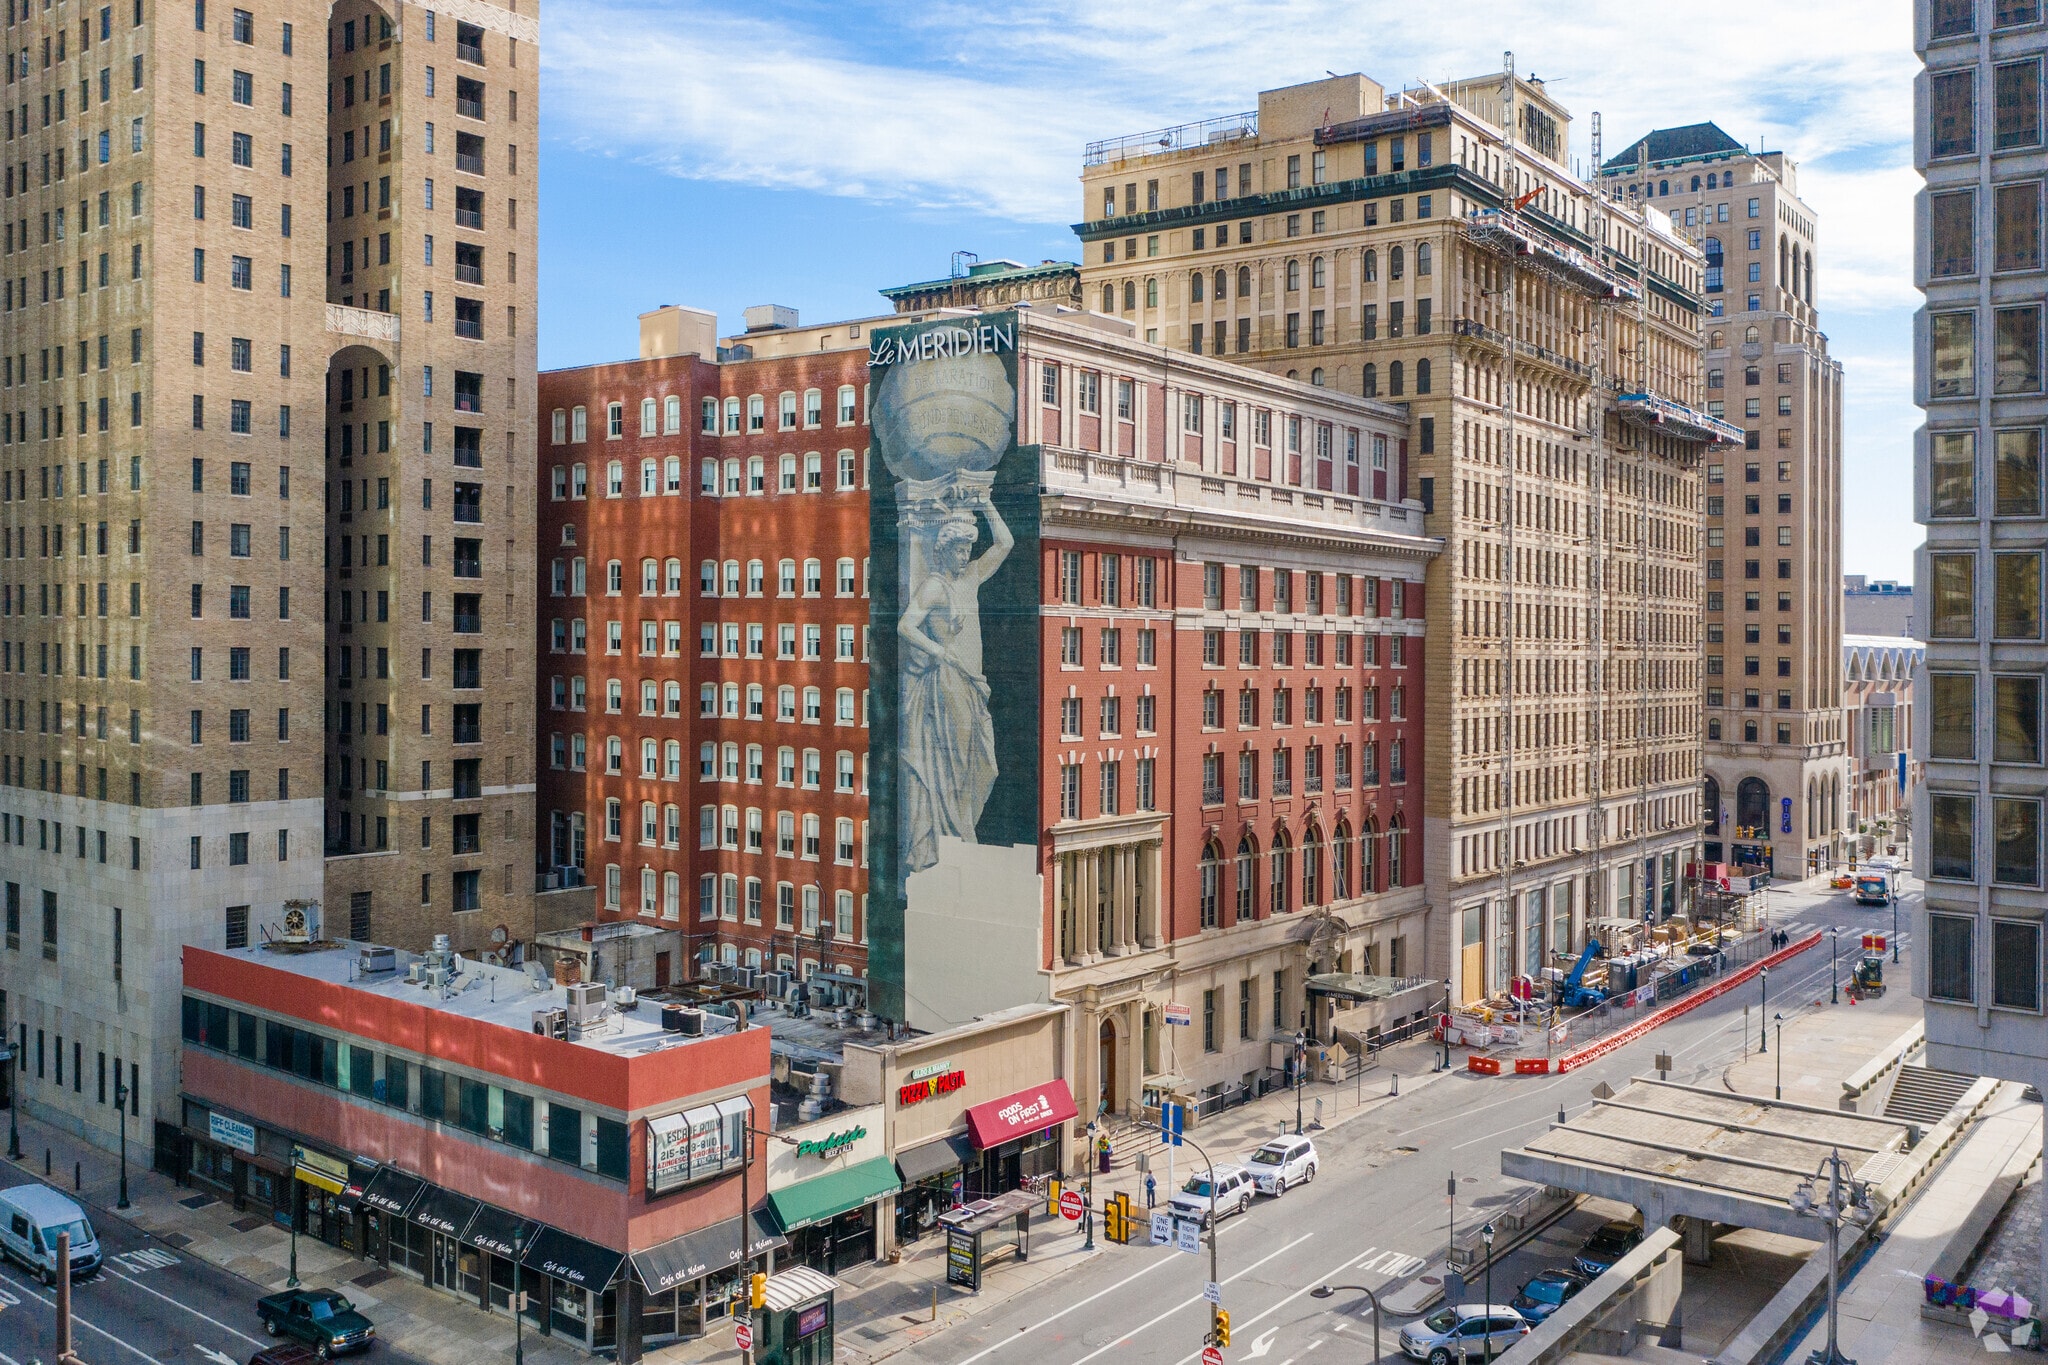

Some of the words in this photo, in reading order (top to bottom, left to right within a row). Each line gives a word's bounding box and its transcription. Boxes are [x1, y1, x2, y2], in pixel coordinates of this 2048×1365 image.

[866, 337, 895, 366] Le
[898, 322, 1014, 363] MERIDIEN
[914, 366, 995, 393] DECLARATION
[900, 1081, 929, 1105] PIZZA
[938, 1070, 966, 1094] PASTA
[998, 1102, 1023, 1120] FOODS
[1008, 1115, 1020, 1126] ON
[1020, 1103, 1039, 1120] FIRST
[797, 1125, 867, 1159] Parkside
[1071, 1196, 1080, 1204] NOT
[1063, 1208, 1079, 1216] ENTER
[1156, 1216, 1169, 1226] ONE
[1156, 1224, 1169, 1234] WAY
[1181, 1224, 1195, 1234] RIGHT
[1182, 1233, 1195, 1242] TURN
[1180, 1241, 1197, 1251] SIGNAL
[109, 1247, 182, 1274] ONLY
[1356, 1250, 1427, 1278] ONLY
[1206, 1287, 1218, 1296] TURN
